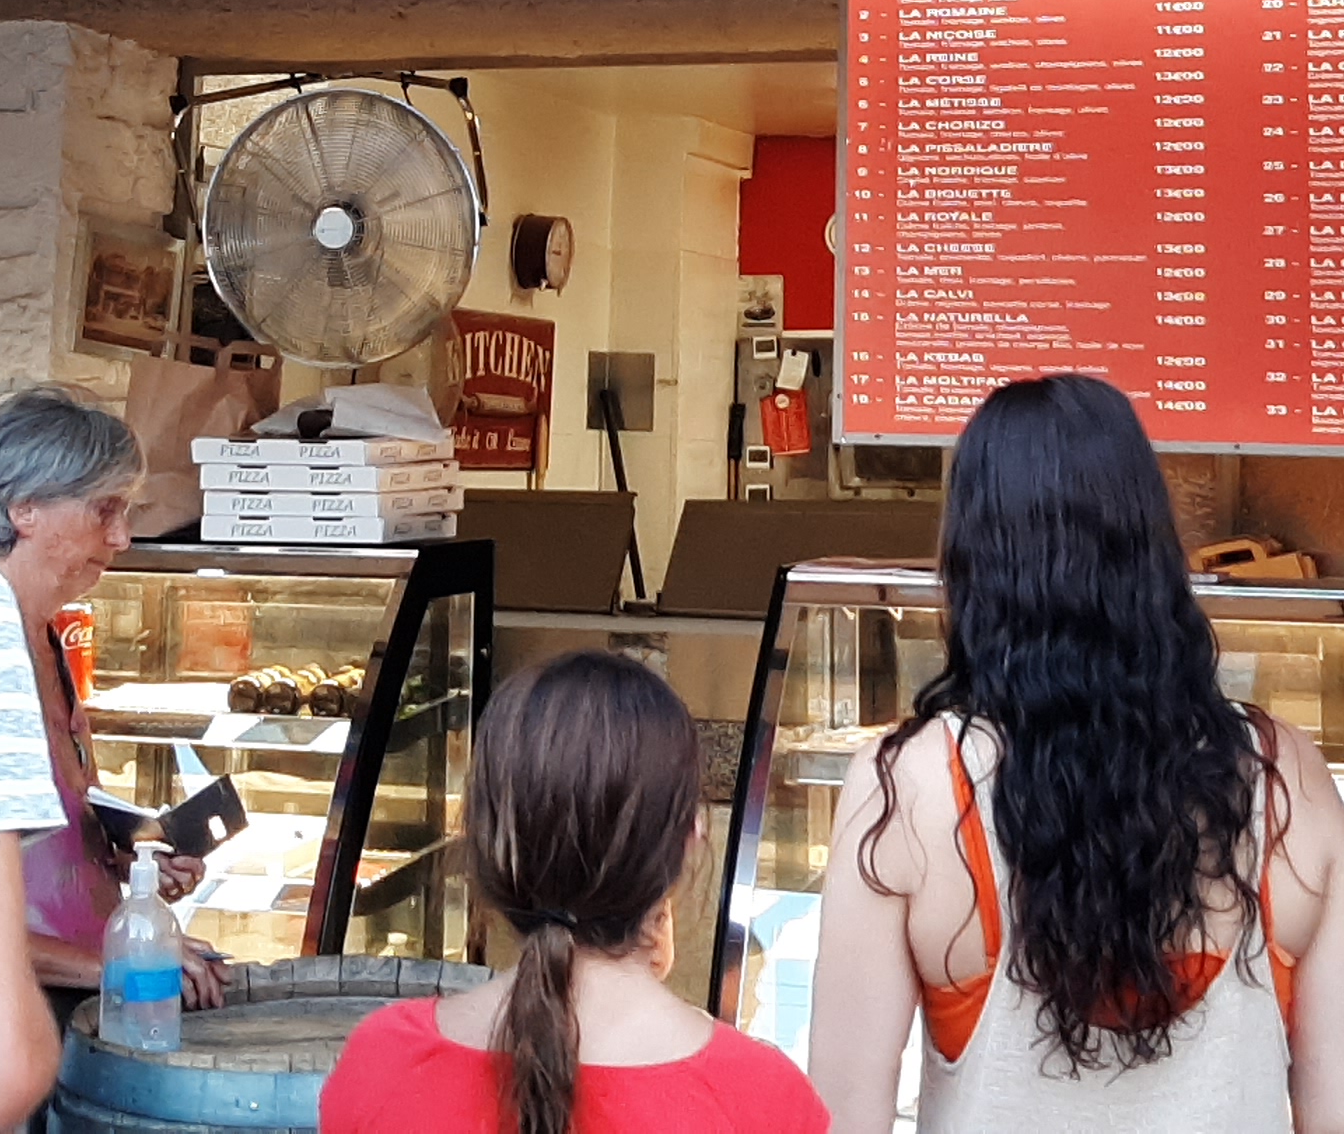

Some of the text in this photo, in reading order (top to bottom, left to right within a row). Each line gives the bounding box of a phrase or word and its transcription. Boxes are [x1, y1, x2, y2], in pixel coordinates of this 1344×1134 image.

[899, 8, 921, 18] LA
[899, 31, 921, 41] LA
[1308, 30, 1332, 39] LA
[899, 53, 921, 63] LA
[1308, 62, 1333, 71] LA
[899, 76, 921, 85] LA
[898, 98, 921, 108] LA
[1308, 94, 1333, 103] LA
[898, 121, 920, 130] LA
[1309, 126, 1333, 136] LA
[898, 144, 920, 153] LA
[1309, 160, 1333, 170] LA
[897, 166, 919, 176] LA
[897, 189, 919, 199] LA
[1310, 193, 1334, 202] LA
[897, 212, 919, 221] LA
[1310, 226, 1334, 235] LA
[896, 243, 919, 253] LA
[1310, 258, 1335, 268] LA
[896, 266, 919, 275] LA
[896, 289, 918, 298] LA
[1311, 291, 1336, 301] LA
[896, 312, 918, 322] LA
[1311, 315, 1336, 325] LA
[1311, 339, 1336, 349] LA
[895, 351, 918, 361] LA
[895, 374, 918, 385] LA
[1311, 372, 1336, 383] LA
[895, 394, 918, 404] LA
[1312, 406, 1336, 416] LA
[220, 444, 260, 457] PIZZA
[299, 445, 341, 458] PIZZA
[228, 471, 269, 484] PIZZA
[310, 472, 352, 485] PIZZA
[232, 498, 273, 511] PIZZA
[312, 499, 353, 512] PIZZA
[231, 524, 273, 537] PIZZA
